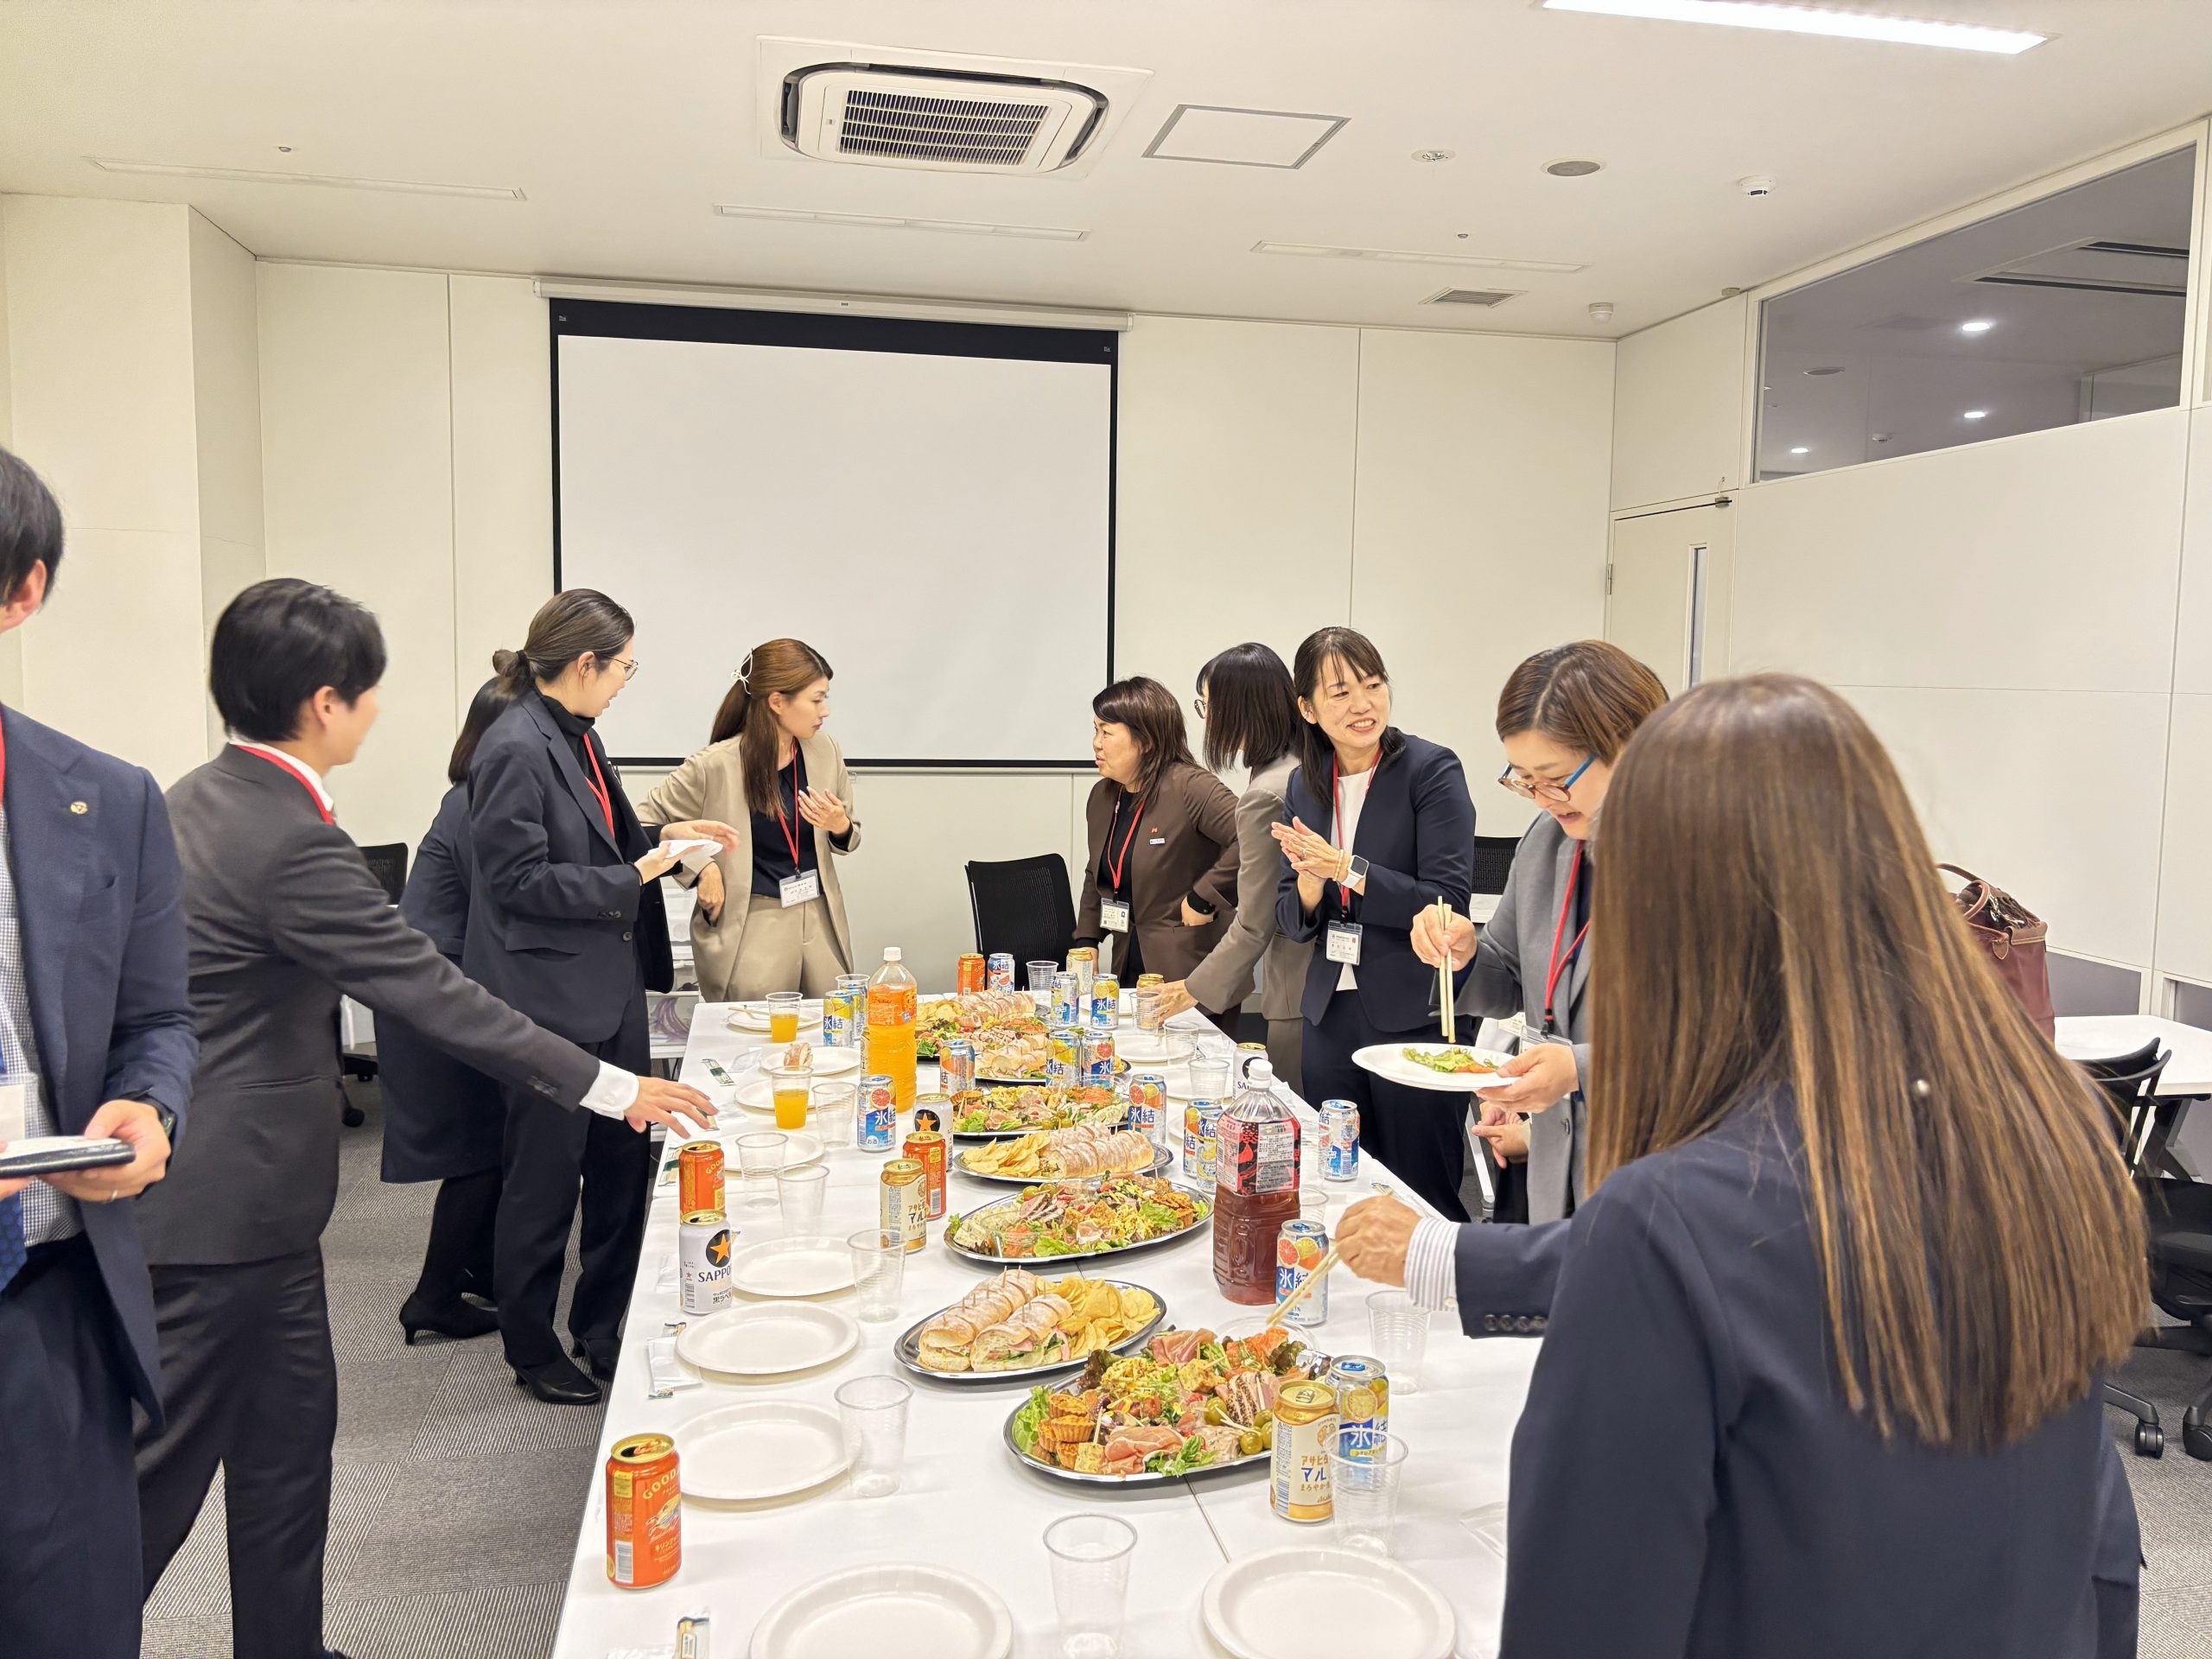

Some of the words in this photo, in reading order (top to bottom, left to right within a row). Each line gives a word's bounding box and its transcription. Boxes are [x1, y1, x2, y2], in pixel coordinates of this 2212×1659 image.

[1097, 999, 1116, 1010] 氷結
[824, 1016, 842, 1029] 氷結
[1131, 1108, 1154, 1122] 氷結
